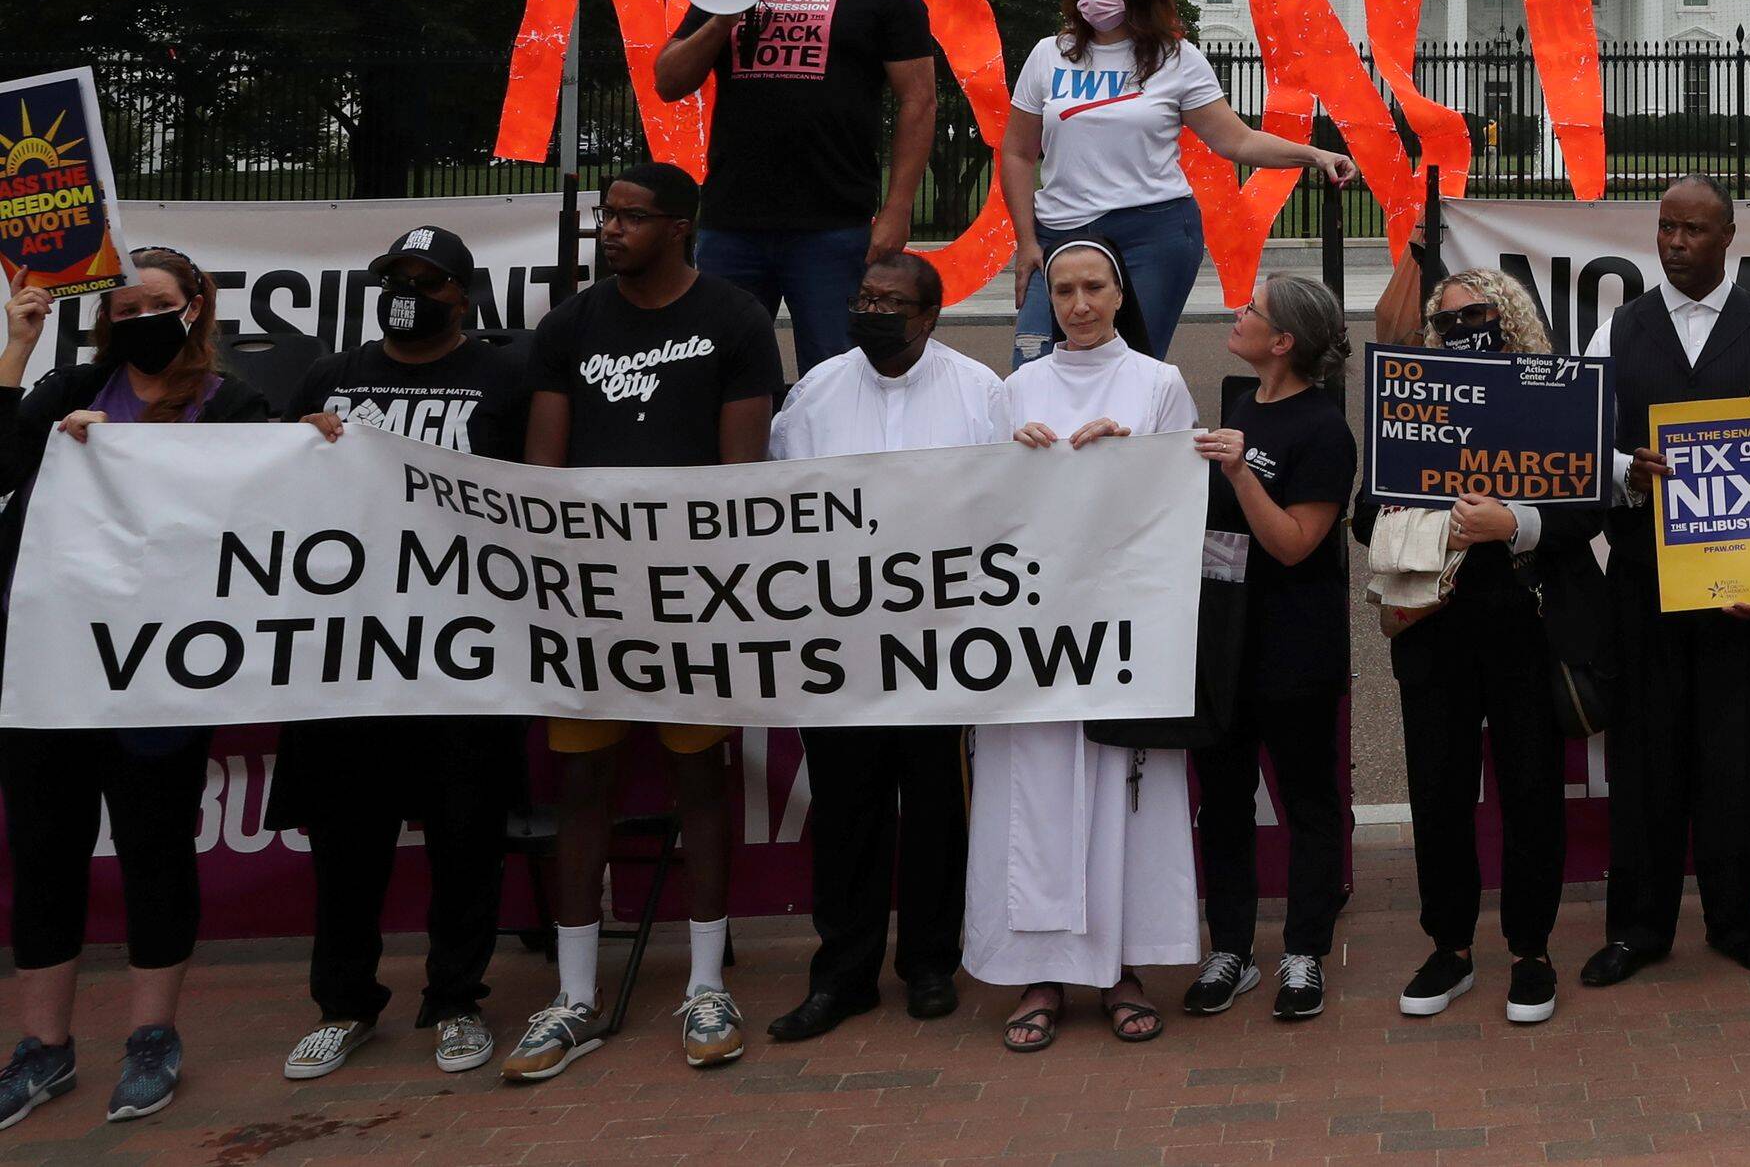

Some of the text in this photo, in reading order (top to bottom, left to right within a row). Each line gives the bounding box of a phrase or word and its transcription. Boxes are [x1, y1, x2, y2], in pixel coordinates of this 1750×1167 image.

[1051, 67, 1130, 100] LWV
[44, 166, 89, 192] THE
[0, 185, 94, 219] REEDOM
[26, 207, 91, 234] VOTE
[21, 233, 66, 256] ACT
[580, 335, 715, 384] Chocolate
[1384, 360, 1424, 380] DO
[1516, 356, 1553, 366] Religious
[1525, 365, 1551, 373] Action
[601, 372, 660, 402] City
[1520, 372, 1546, 380] Center
[371, 386, 390, 394] YOU
[390, 387, 429, 395] MATTER.
[445, 388, 483, 397] MATTER.
[1380, 379, 1486, 405] JUSTICE
[1382, 401, 1449, 424] LOVE
[1381, 420, 1473, 445] MERCY
[1665, 433, 1696, 443] TELL
[1697, 430, 1721, 441] THE
[1459, 448, 1594, 475] MARCH
[1666, 443, 1735, 475] FIX
[1421, 469, 1592, 498] PROUDLY
[404, 463, 880, 542] PRESIDENT BIDEN,
[1671, 522, 1687, 532] THE
[216, 529, 1041, 623] NO MORE EXCUSES:
[90, 615, 1133, 698] VOTING RIGHTS NOW!
